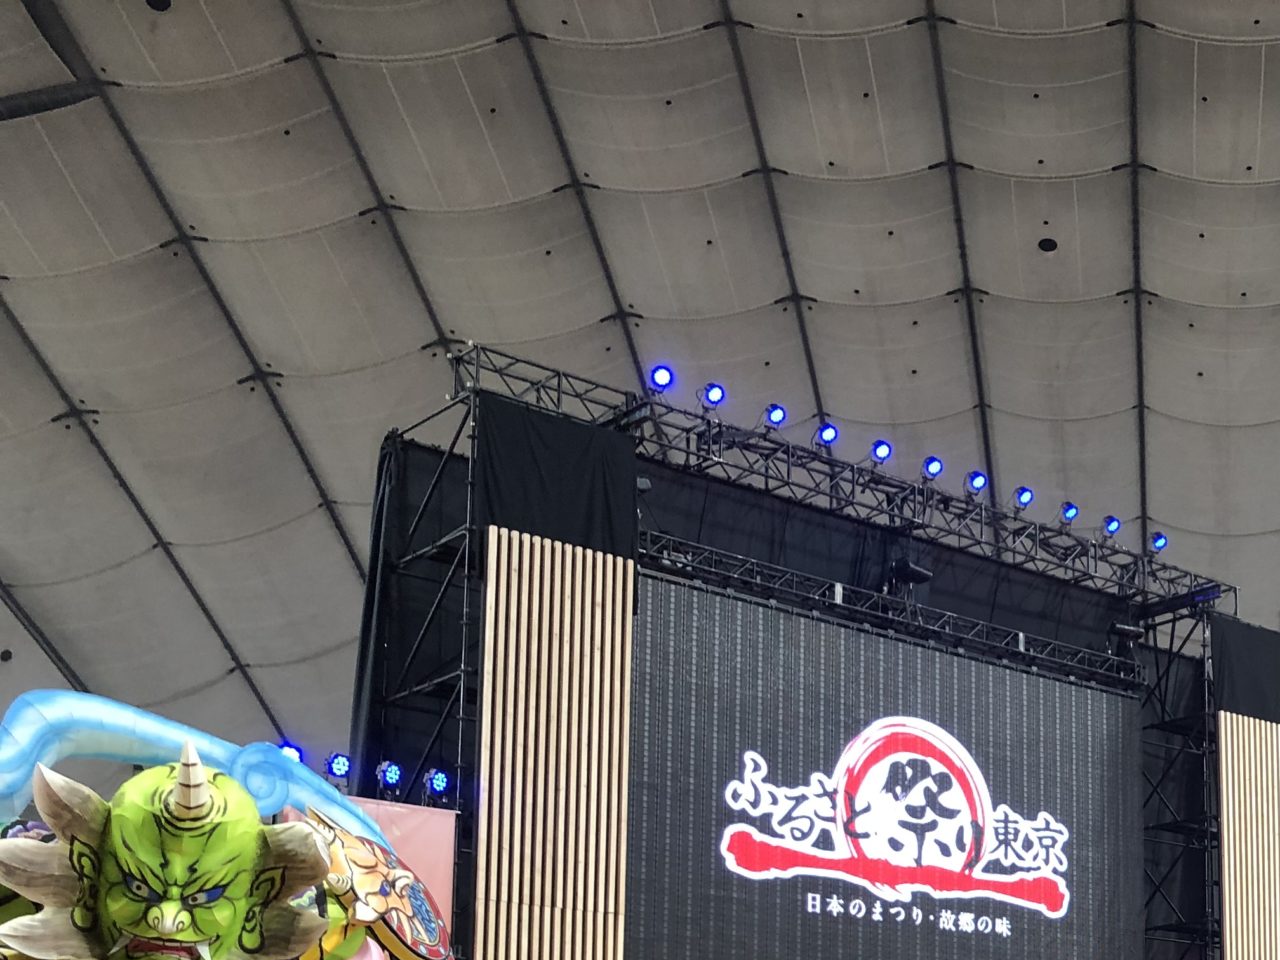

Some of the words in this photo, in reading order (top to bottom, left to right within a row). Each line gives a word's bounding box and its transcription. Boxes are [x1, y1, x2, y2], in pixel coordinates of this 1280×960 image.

[807, 892, 1013, 938] 日本のまつり・故郷の味
